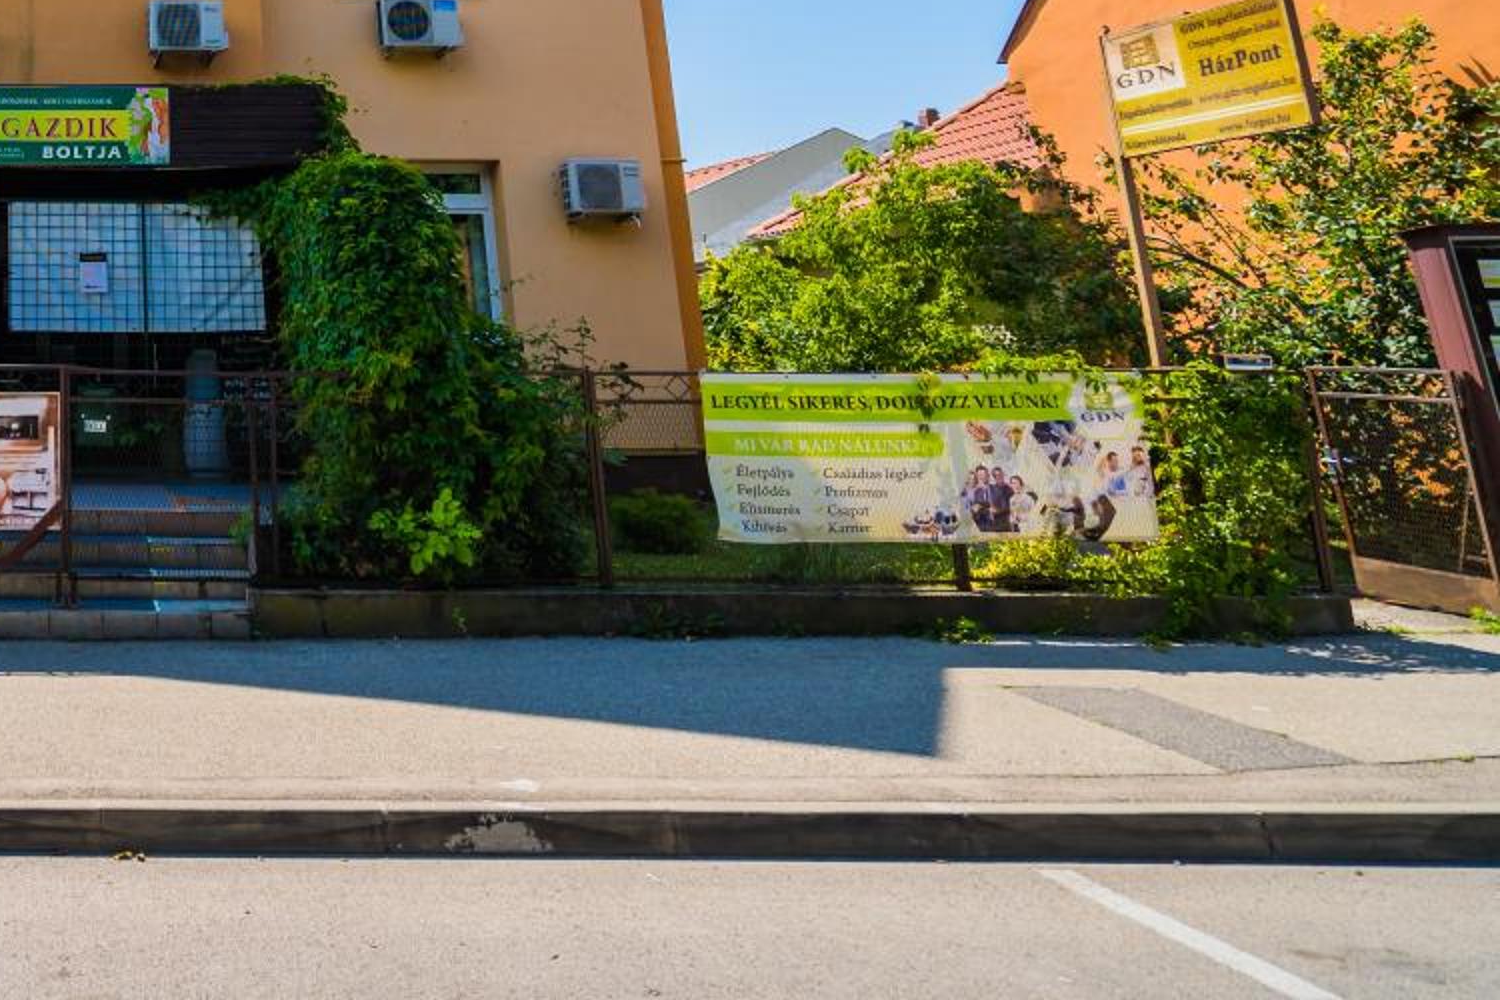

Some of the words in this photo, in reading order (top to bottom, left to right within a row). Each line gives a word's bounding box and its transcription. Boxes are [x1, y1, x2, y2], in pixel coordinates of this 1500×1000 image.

[1199, 43, 1281, 76] HázPont
[1117, 61, 1176, 88] GDN
[1, 116, 117, 137] GAZDIK
[42, 145, 121, 159] BOLTJA
[711, 393, 784, 409] LEGYÉL
[788, 395, 873, 412] SIKERES,
[973, 391, 1059, 409] VELÜNK!
[1081, 411, 1124, 422] GDN
[736, 463, 795, 481] Életpálya
